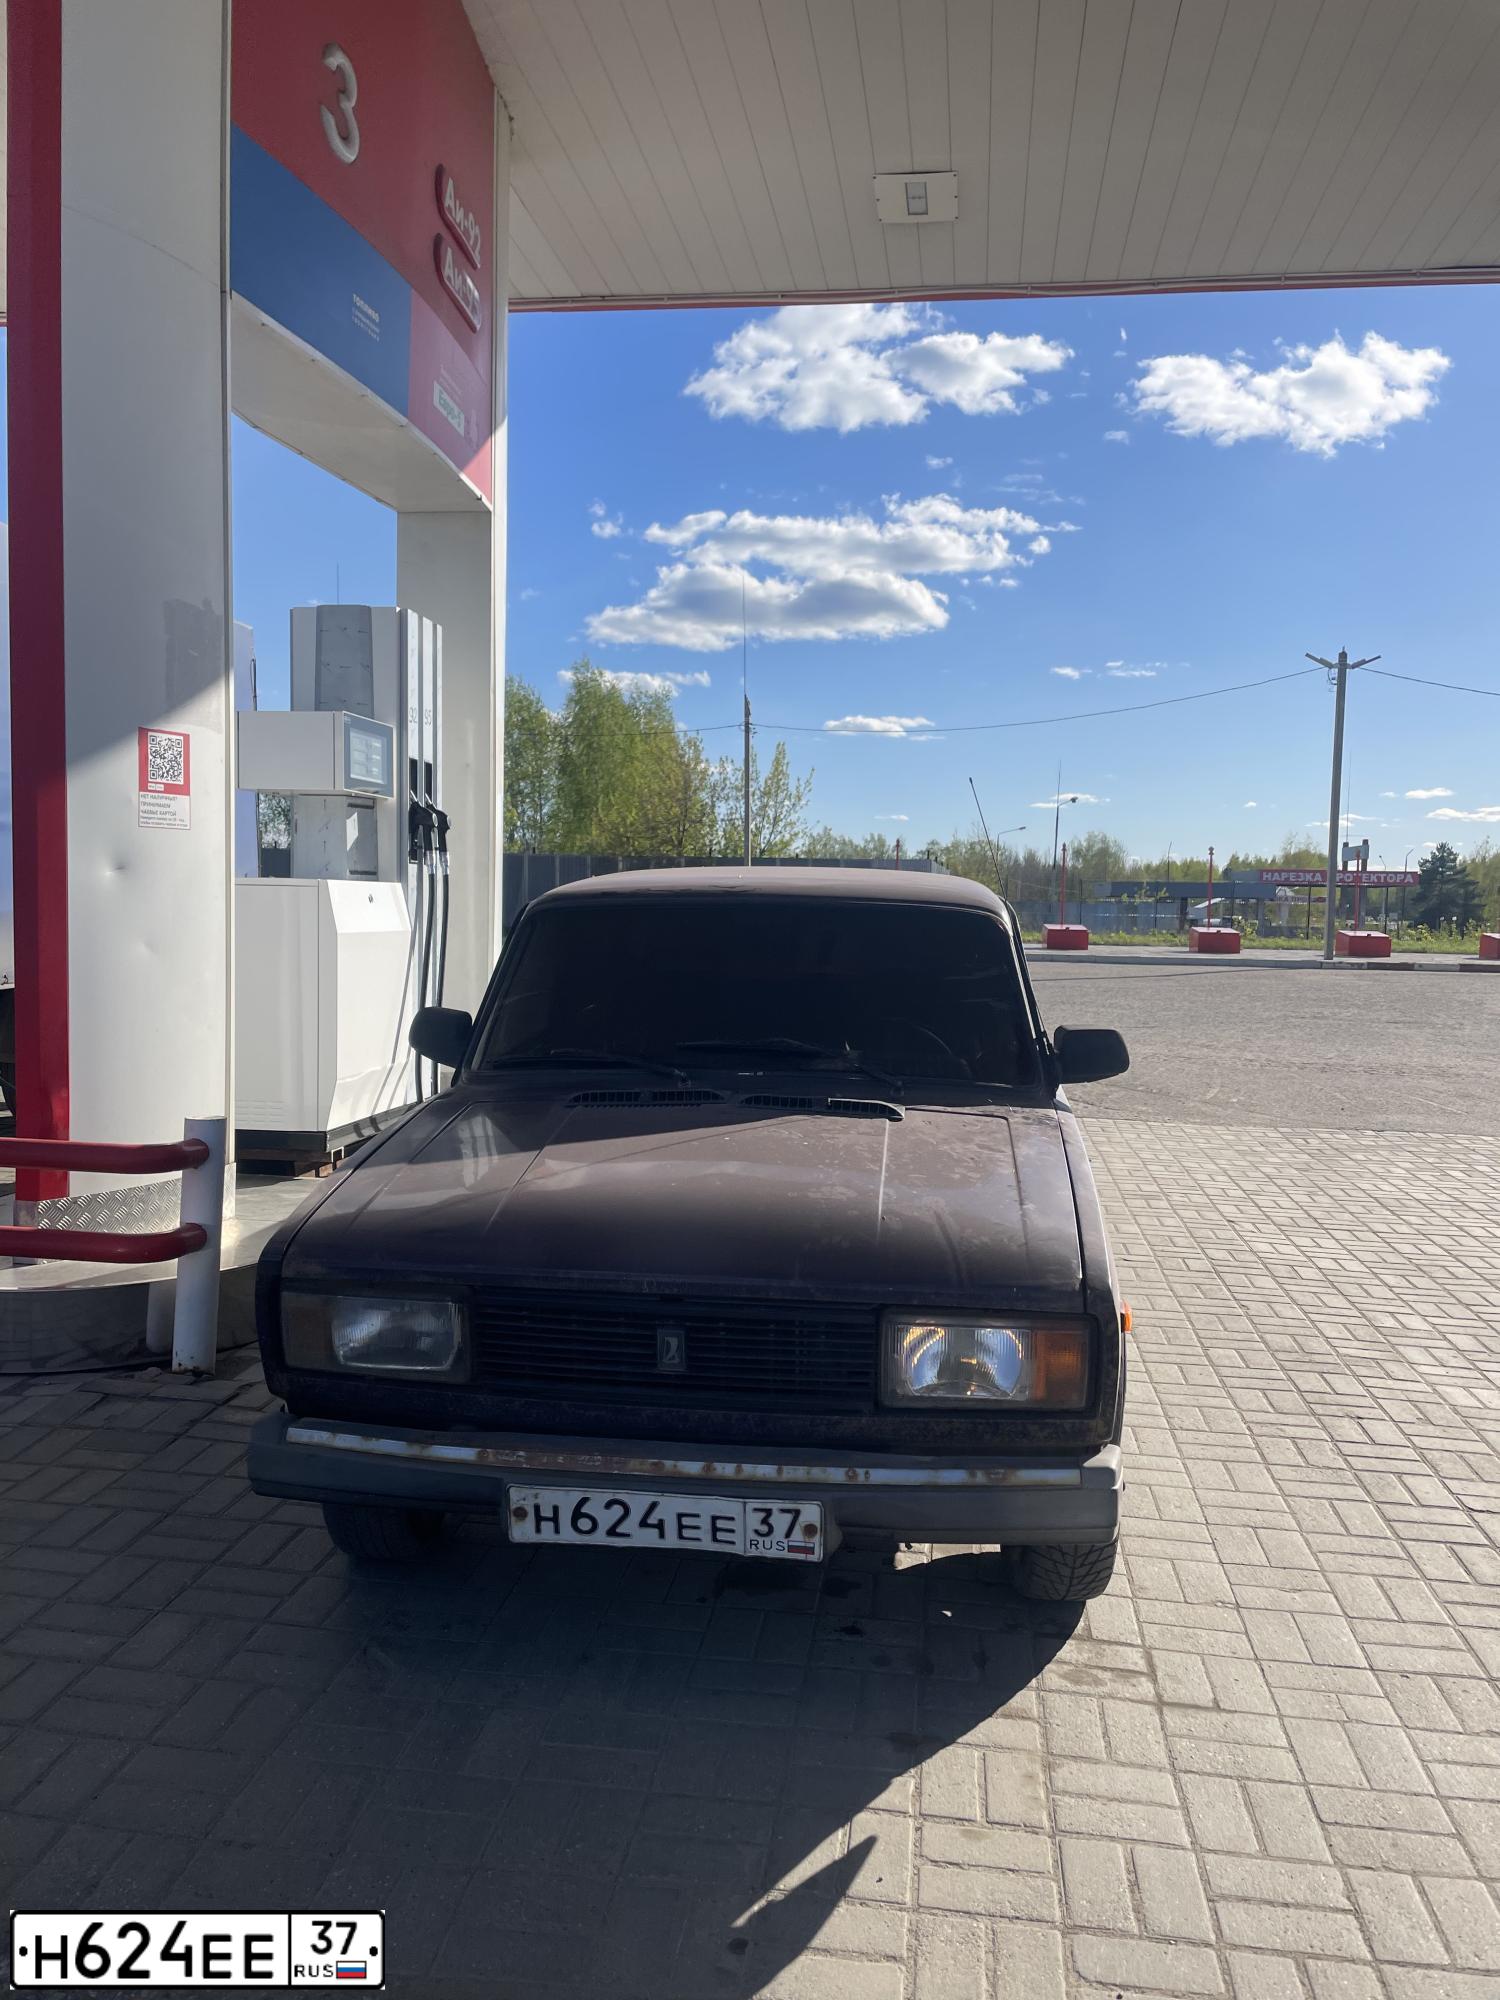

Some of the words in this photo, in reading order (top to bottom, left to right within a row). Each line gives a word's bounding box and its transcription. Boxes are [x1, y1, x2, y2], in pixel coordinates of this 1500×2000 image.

[320, 42, 360, 164] 3
[444, 177, 481, 269] Аи-92
[408, 705, 418, 724] 92
[1262, 871, 1323, 883] НАРЕЗКА
[1328, 872, 1415, 884] РОЕКТОРА
[533, 1496, 737, 1546] Н624ЕЕ
[752, 1508, 802, 1540] 37
[749, 1538, 786, 1553] RUS
